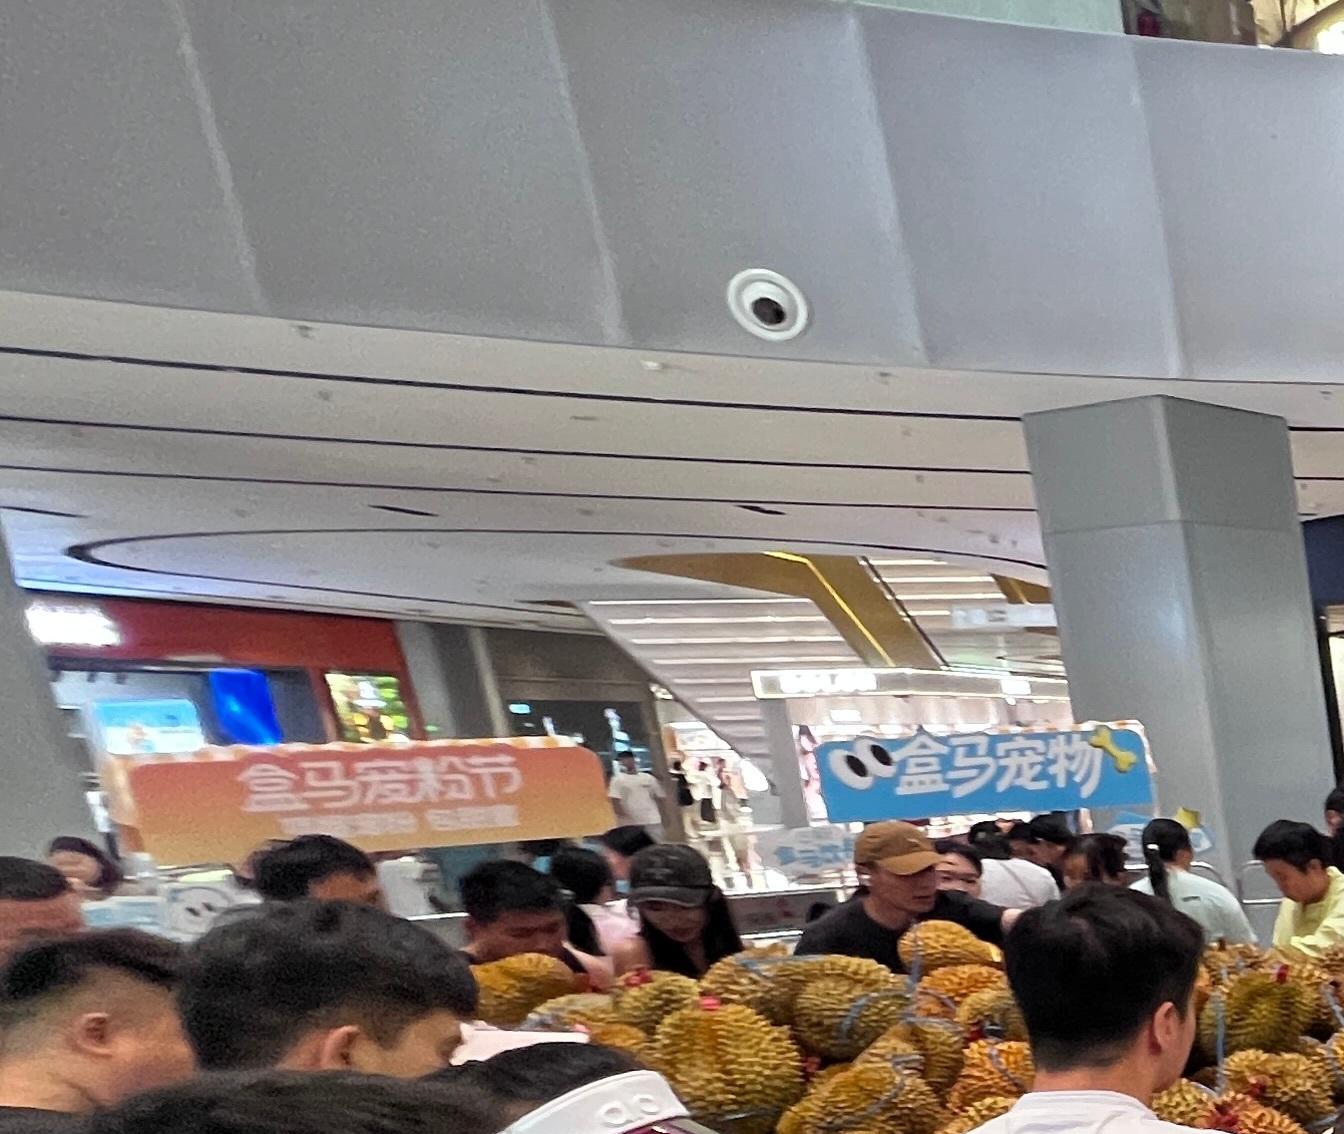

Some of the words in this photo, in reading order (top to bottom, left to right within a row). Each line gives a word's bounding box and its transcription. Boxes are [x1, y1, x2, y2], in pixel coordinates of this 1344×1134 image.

[237, 754, 523, 813] 盒马宠粉节
[895, 728, 1104, 799] 盒马宠物
